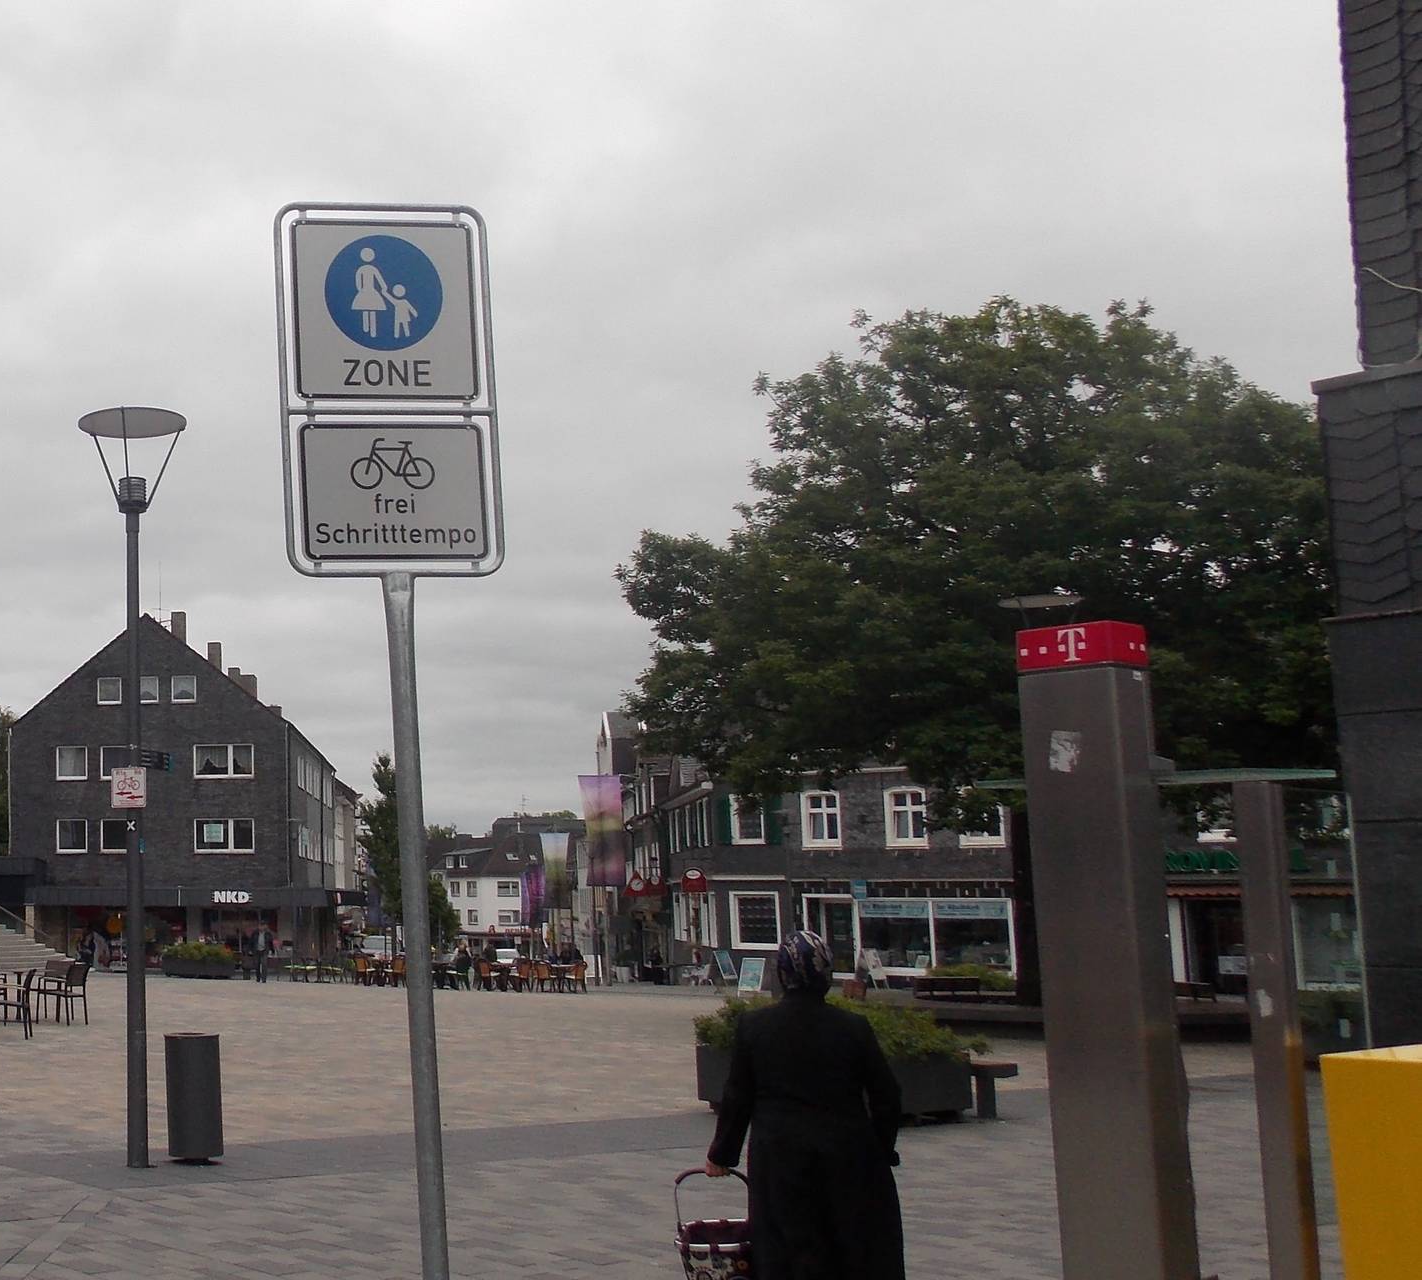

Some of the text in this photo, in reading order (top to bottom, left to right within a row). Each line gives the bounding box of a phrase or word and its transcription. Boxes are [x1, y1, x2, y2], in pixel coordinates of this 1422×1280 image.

[343, 359, 432, 387] ZONE
[374, 493, 415, 514] frei
[315, 522, 476, 549] Schritttempo
[213, 890, 250, 904] NKD
